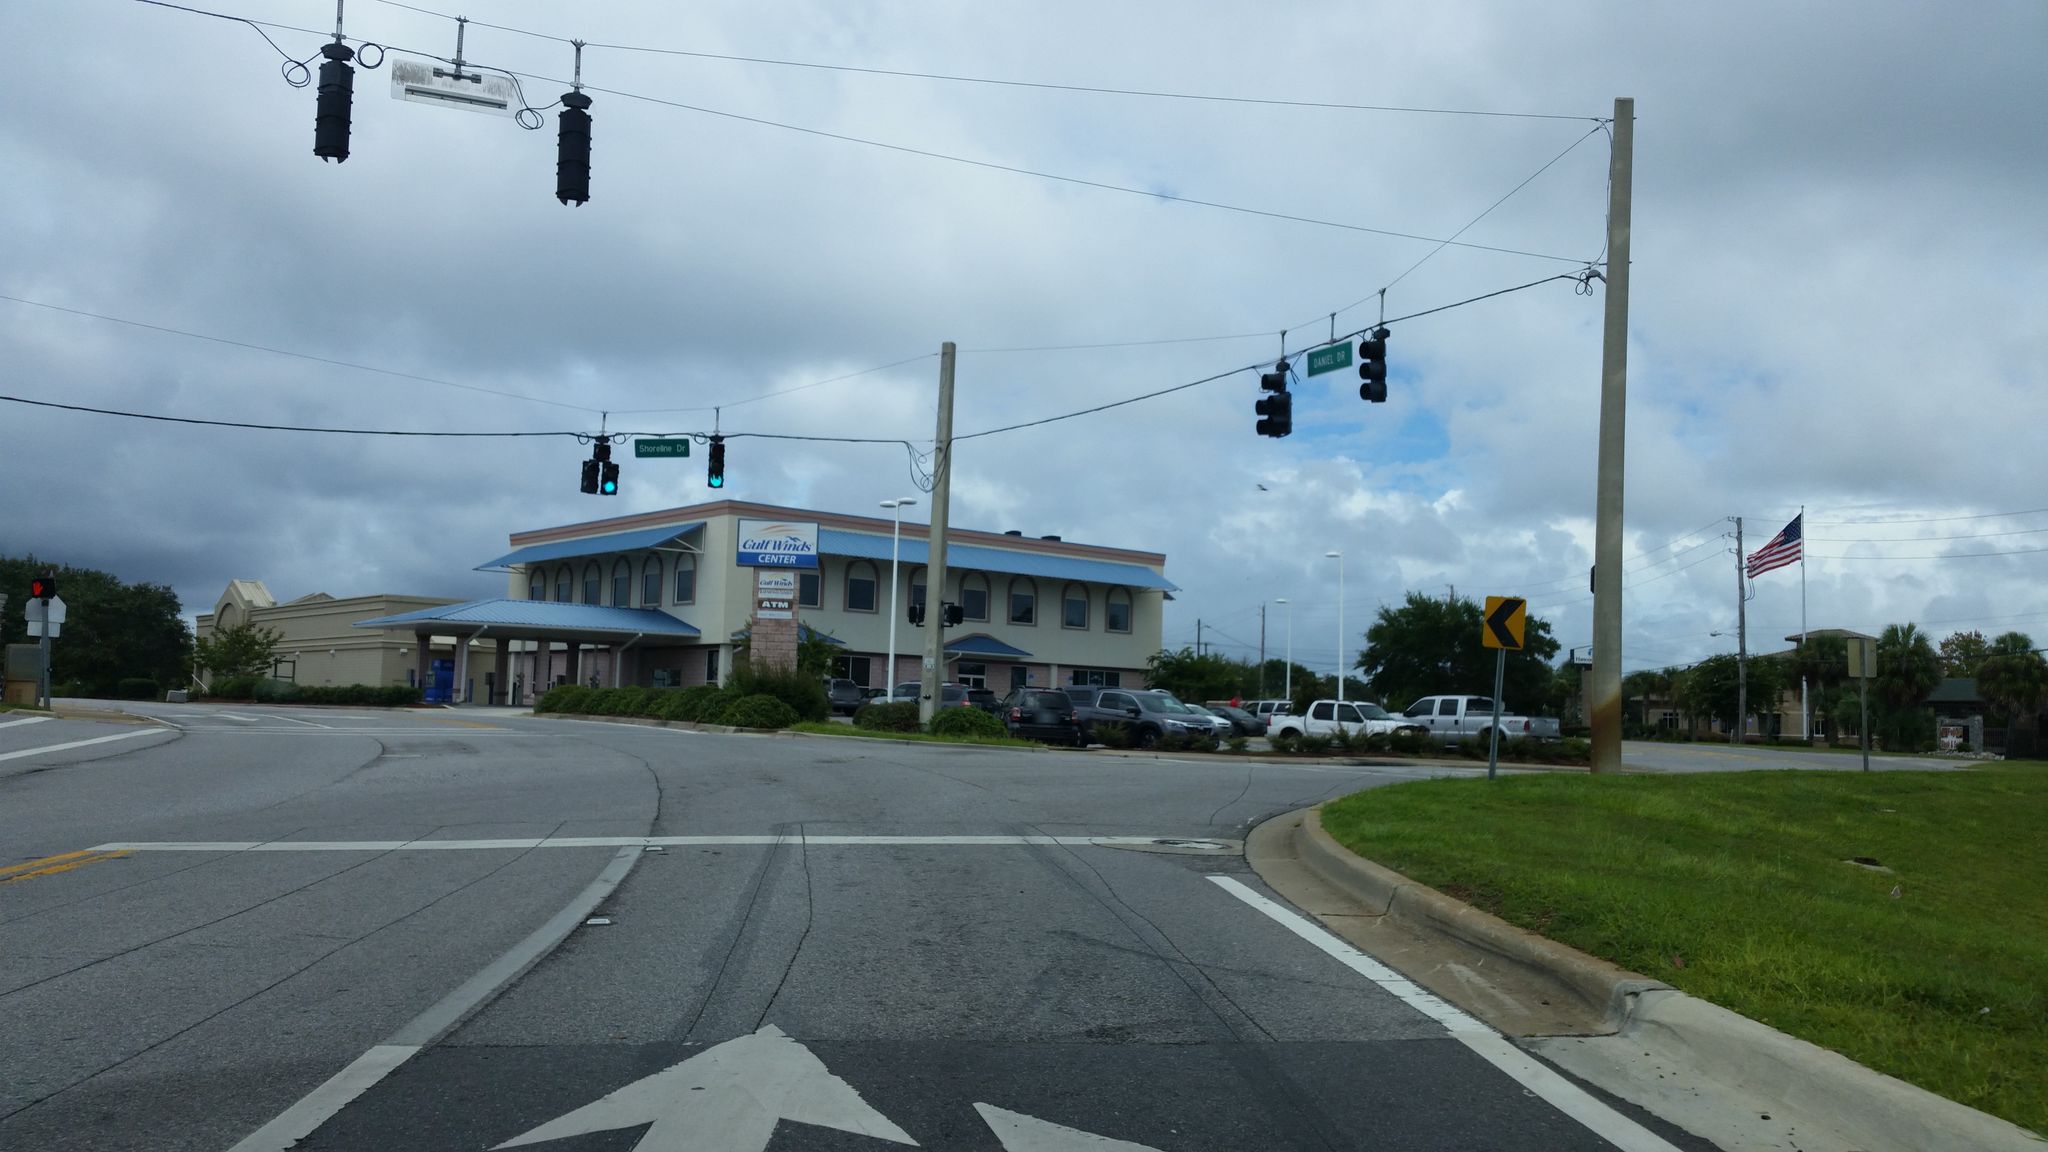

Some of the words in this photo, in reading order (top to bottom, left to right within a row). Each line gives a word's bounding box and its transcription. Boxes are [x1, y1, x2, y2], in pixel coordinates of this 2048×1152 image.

[1313, 354, 1334, 369] DANIEL
[1336, 351, 1346, 362] DR
[640, 444, 672, 453] Shoreline
[676, 444, 686, 452] Dr
[742, 539, 772, 550] Gulf
[773, 540, 812, 552] Winds
[758, 554, 797, 564] CENTER
[761, 600, 789, 609] ATM
